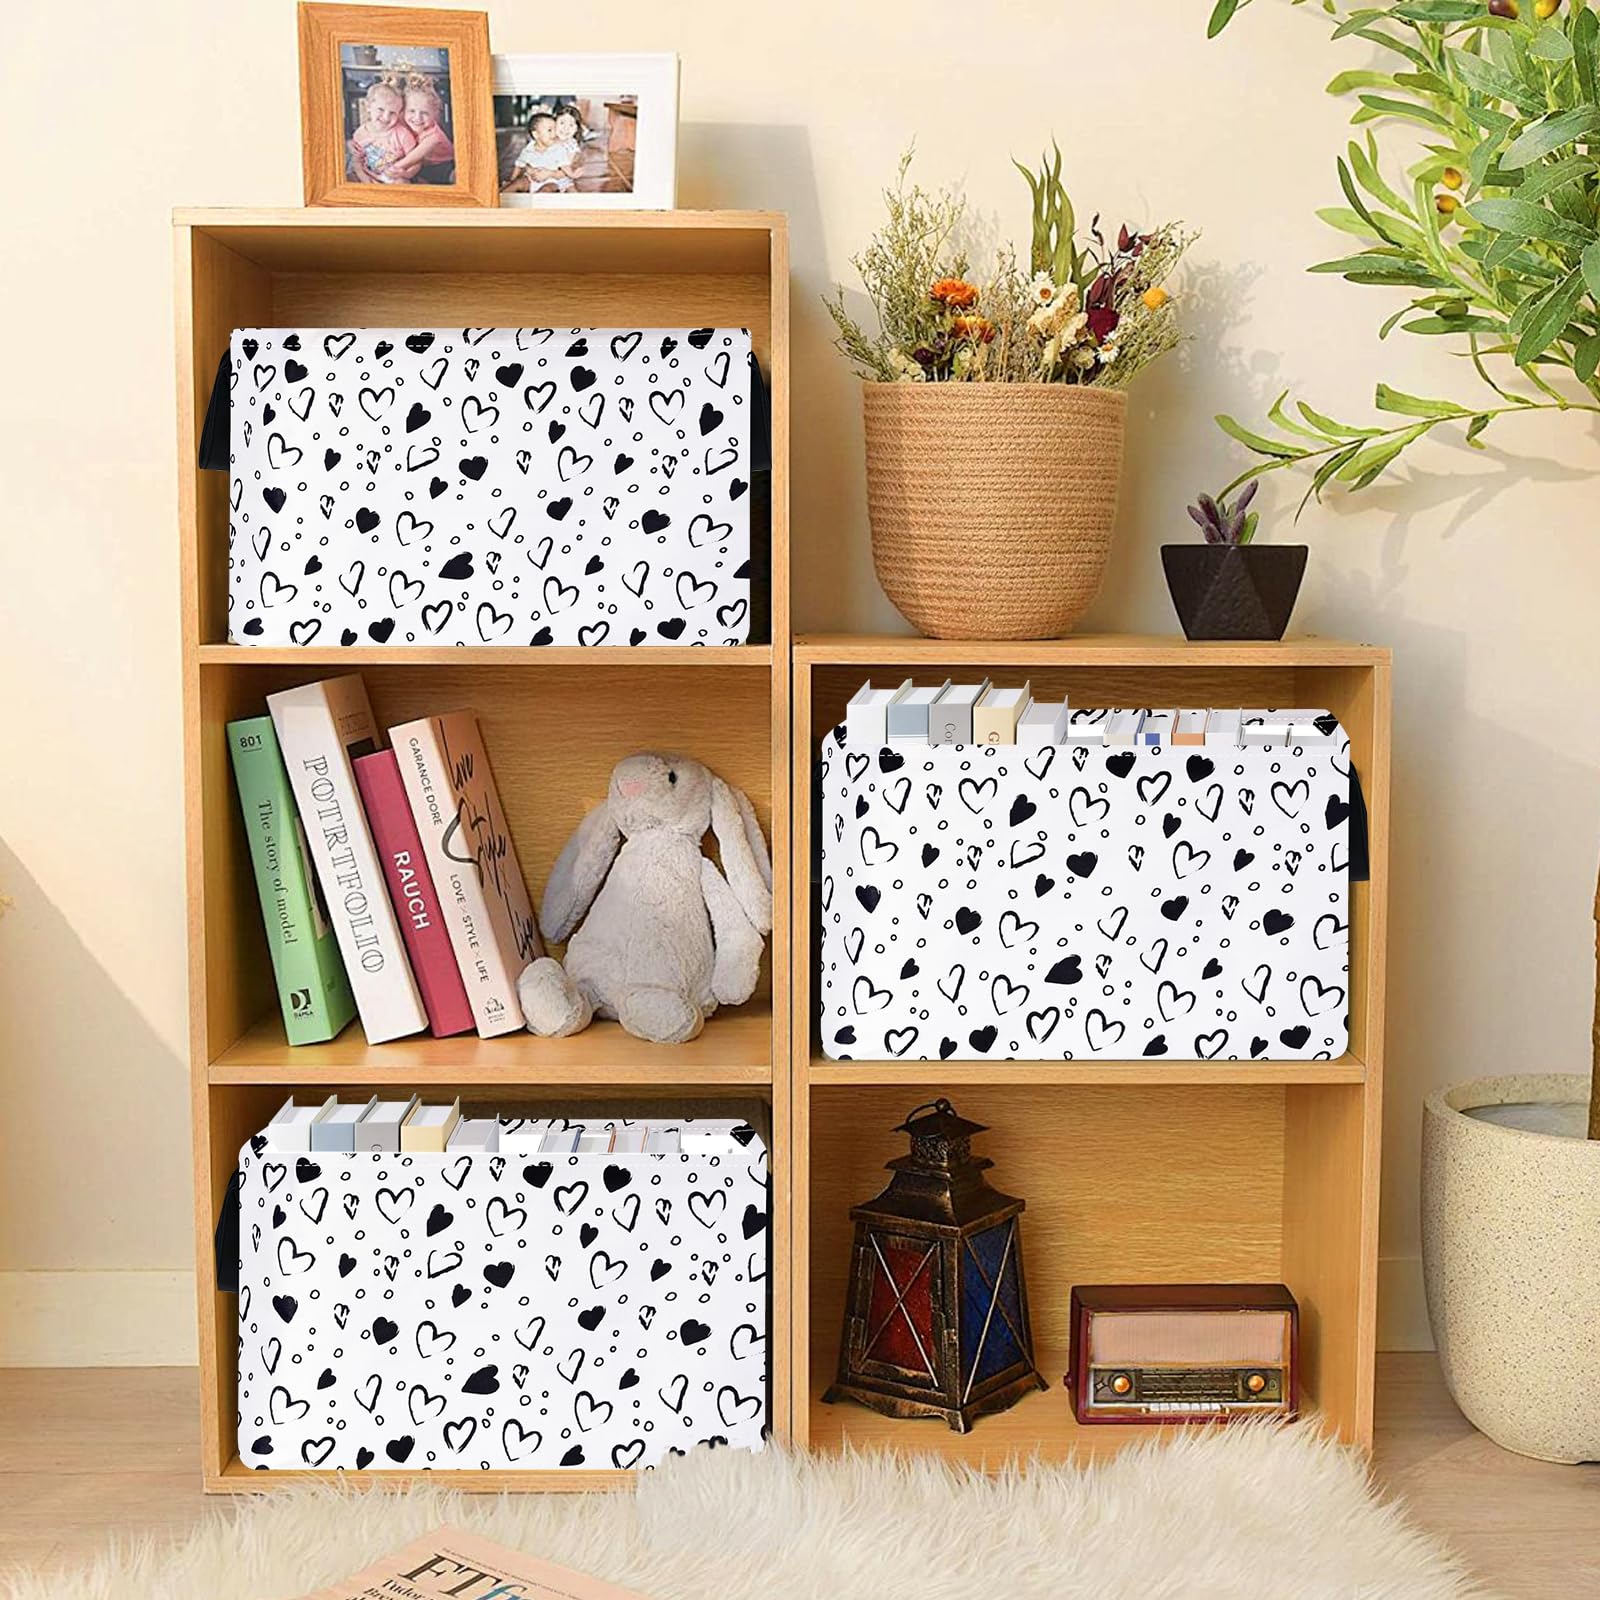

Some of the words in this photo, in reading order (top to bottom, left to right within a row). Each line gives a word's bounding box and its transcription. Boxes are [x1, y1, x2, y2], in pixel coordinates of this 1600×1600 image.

[239, 735, 263, 749] 801
[409, 737, 433, 793] GARANCE
[258, 800, 273, 830] The
[264, 835, 281, 872] story
[273, 878, 289, 894] of
[393, 851, 431, 931] RAUCH
[277, 898, 298, 944] model
[449, 873, 466, 905] LOVE
[462, 914, 479, 950] STYLE
[475, 960, 490, 984] LIFE
